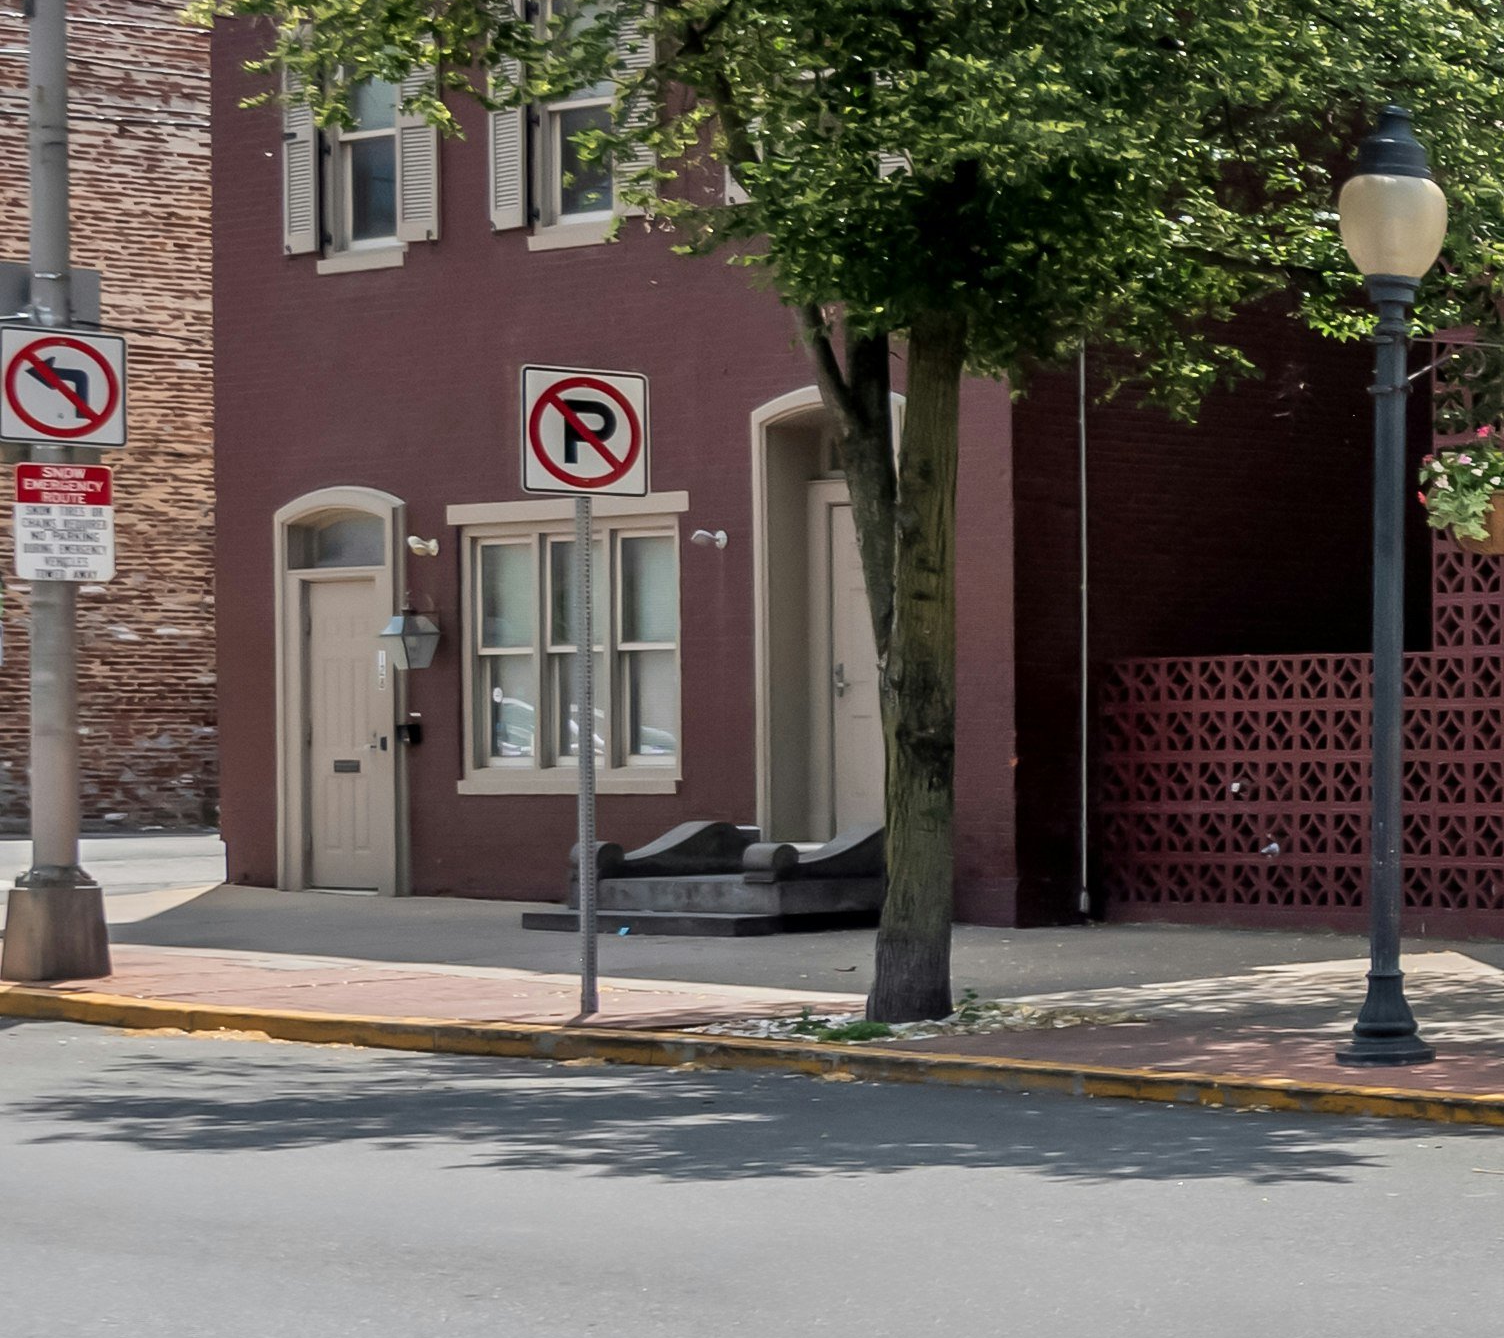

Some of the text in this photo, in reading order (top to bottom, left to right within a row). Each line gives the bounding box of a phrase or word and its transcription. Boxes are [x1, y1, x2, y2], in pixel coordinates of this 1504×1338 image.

[42, 467, 86, 479] SNOW
[23, 479, 104, 492] EMERGENCY
[41, 492, 87, 504] ROUTE
